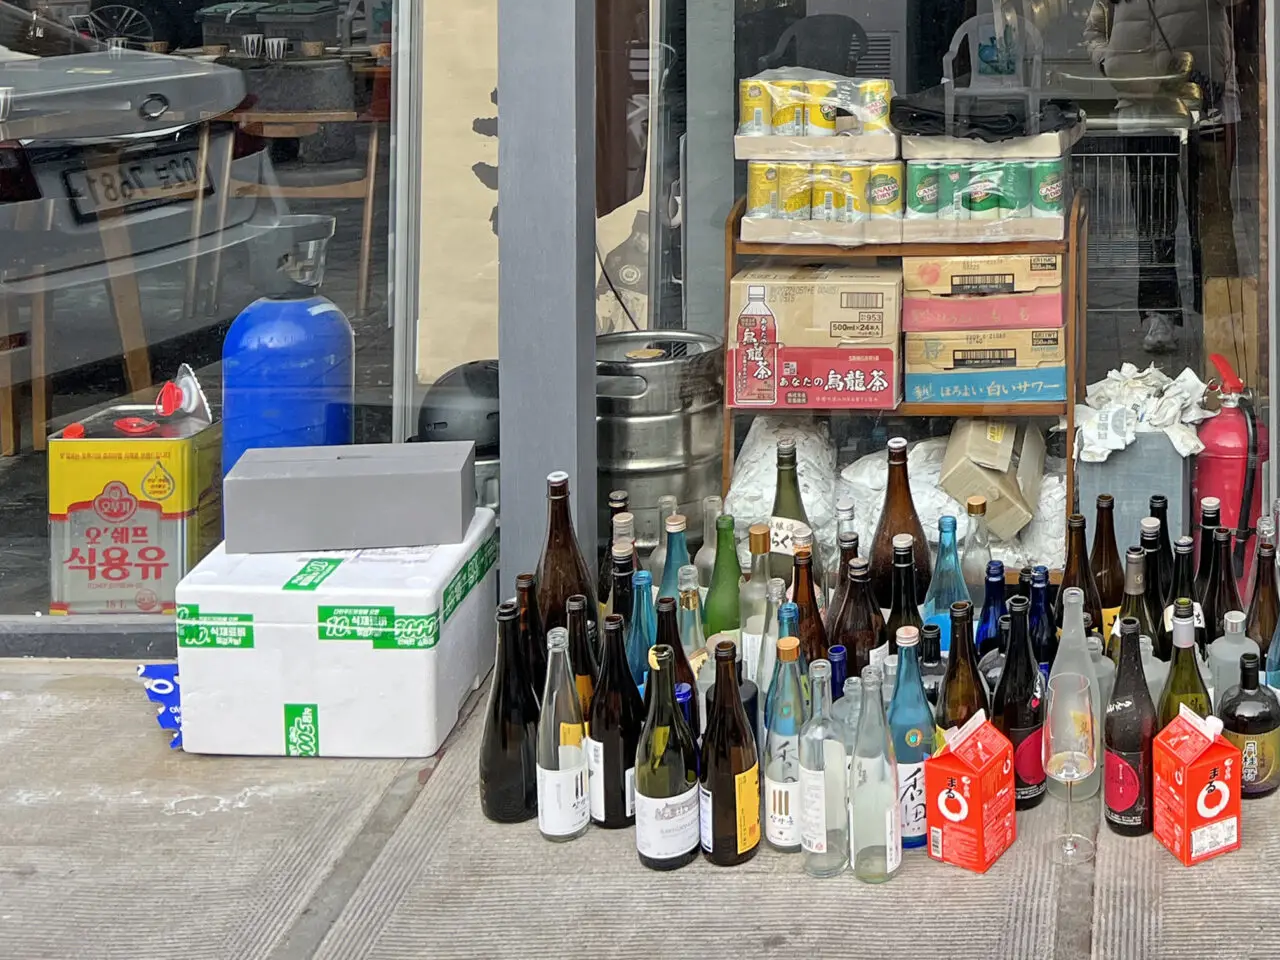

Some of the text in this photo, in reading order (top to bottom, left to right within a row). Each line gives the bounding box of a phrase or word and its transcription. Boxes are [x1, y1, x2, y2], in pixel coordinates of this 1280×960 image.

[866, 314, 882, 322] 953
[101, 501, 131, 515] 오뚜기
[63, 546, 169, 581] 식용유
